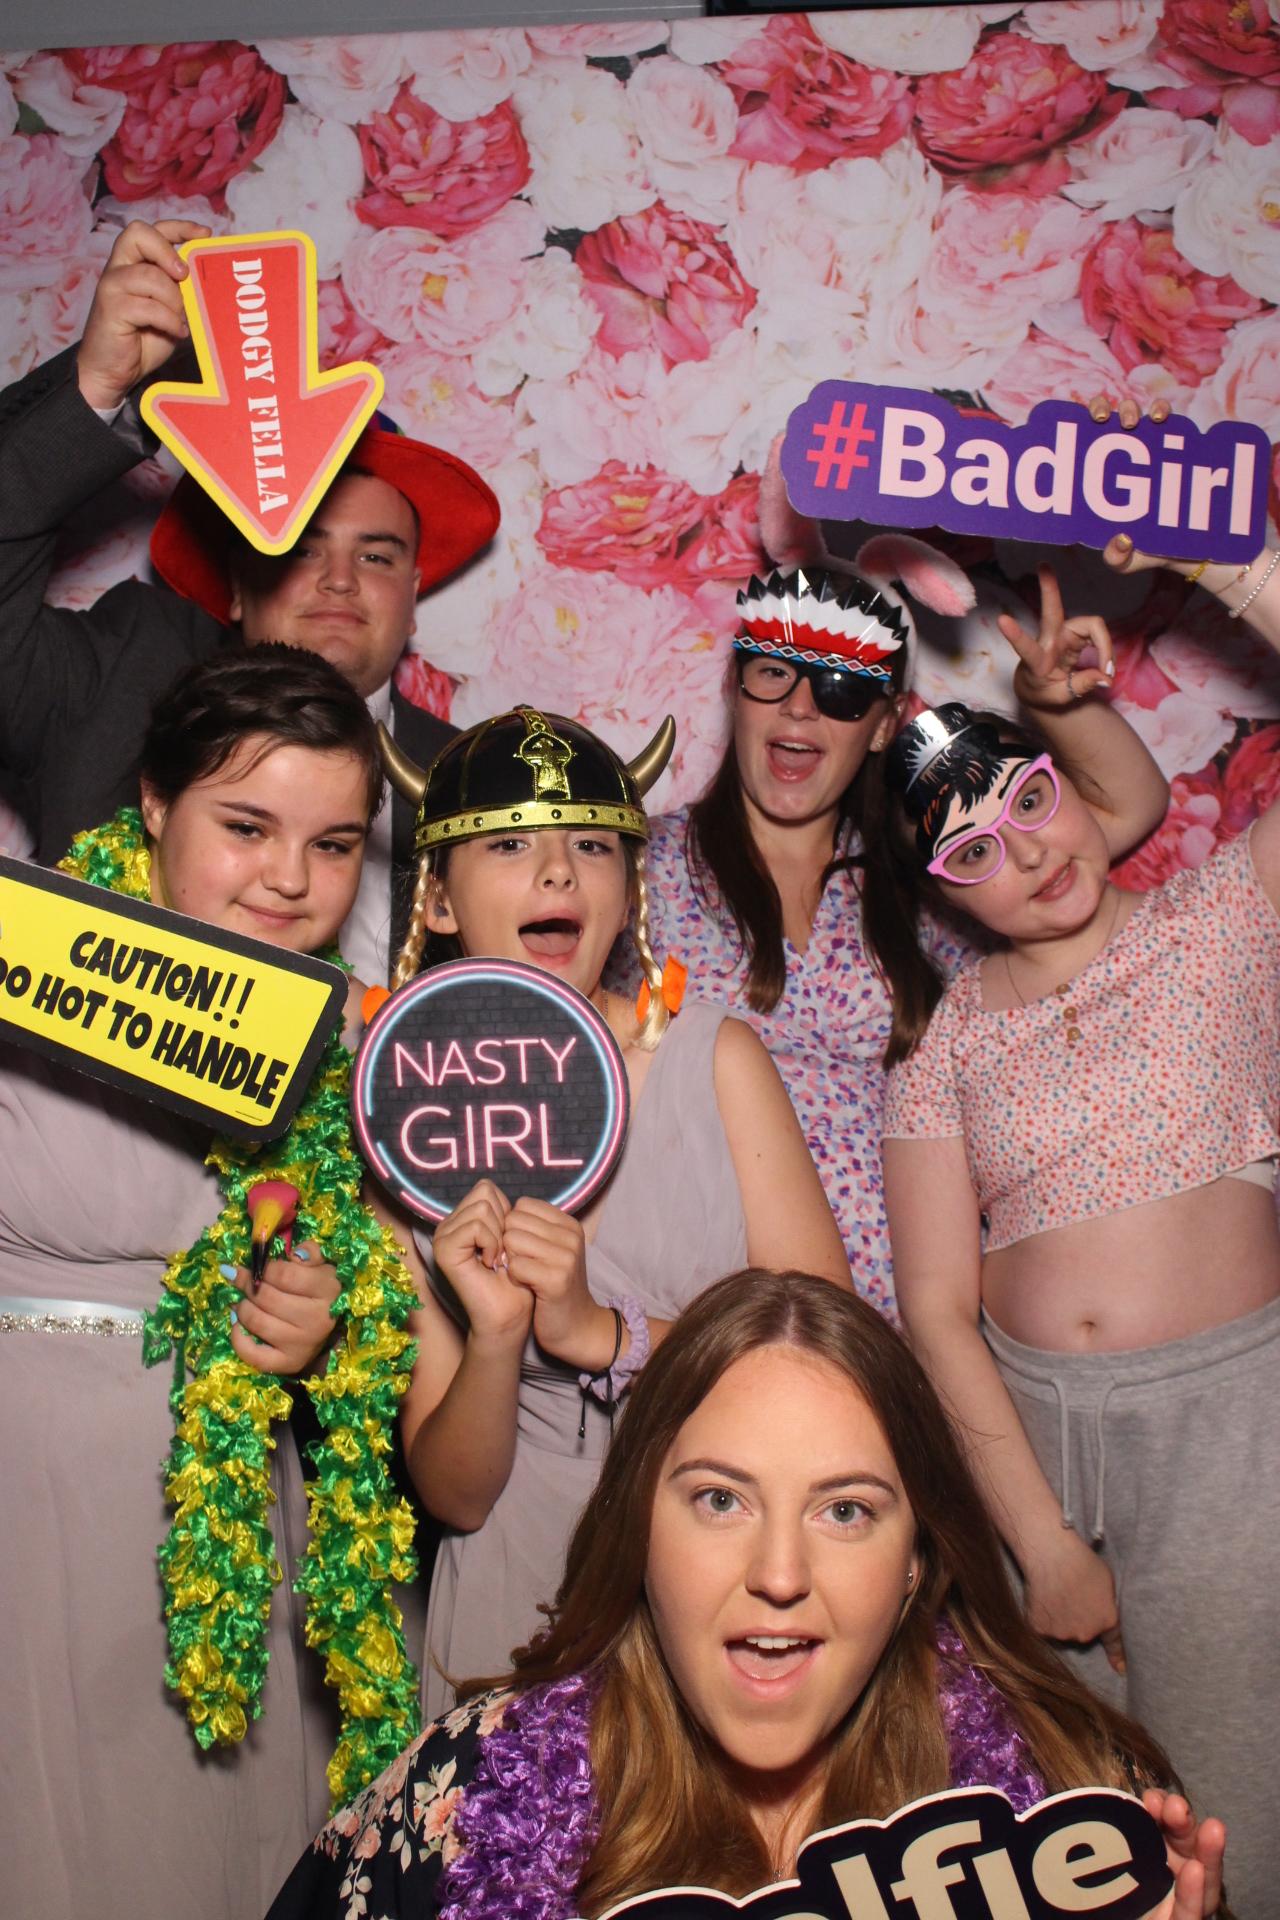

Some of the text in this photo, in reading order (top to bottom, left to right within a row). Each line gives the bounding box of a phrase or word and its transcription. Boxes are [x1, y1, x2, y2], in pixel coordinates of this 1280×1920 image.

[231, 258, 289, 514] DODGY FELLA
[805, 399, 1257, 537] #BadGirl
[69, 930, 256, 1030] CAUTION!!
[31, 972, 109, 1029] HOT
[107, 999, 153, 1050] TO
[150, 1018, 290, 1110] HANDLE
[393, 1036, 577, 1088] NASTY
[400, 1102, 584, 1170] GIRL
